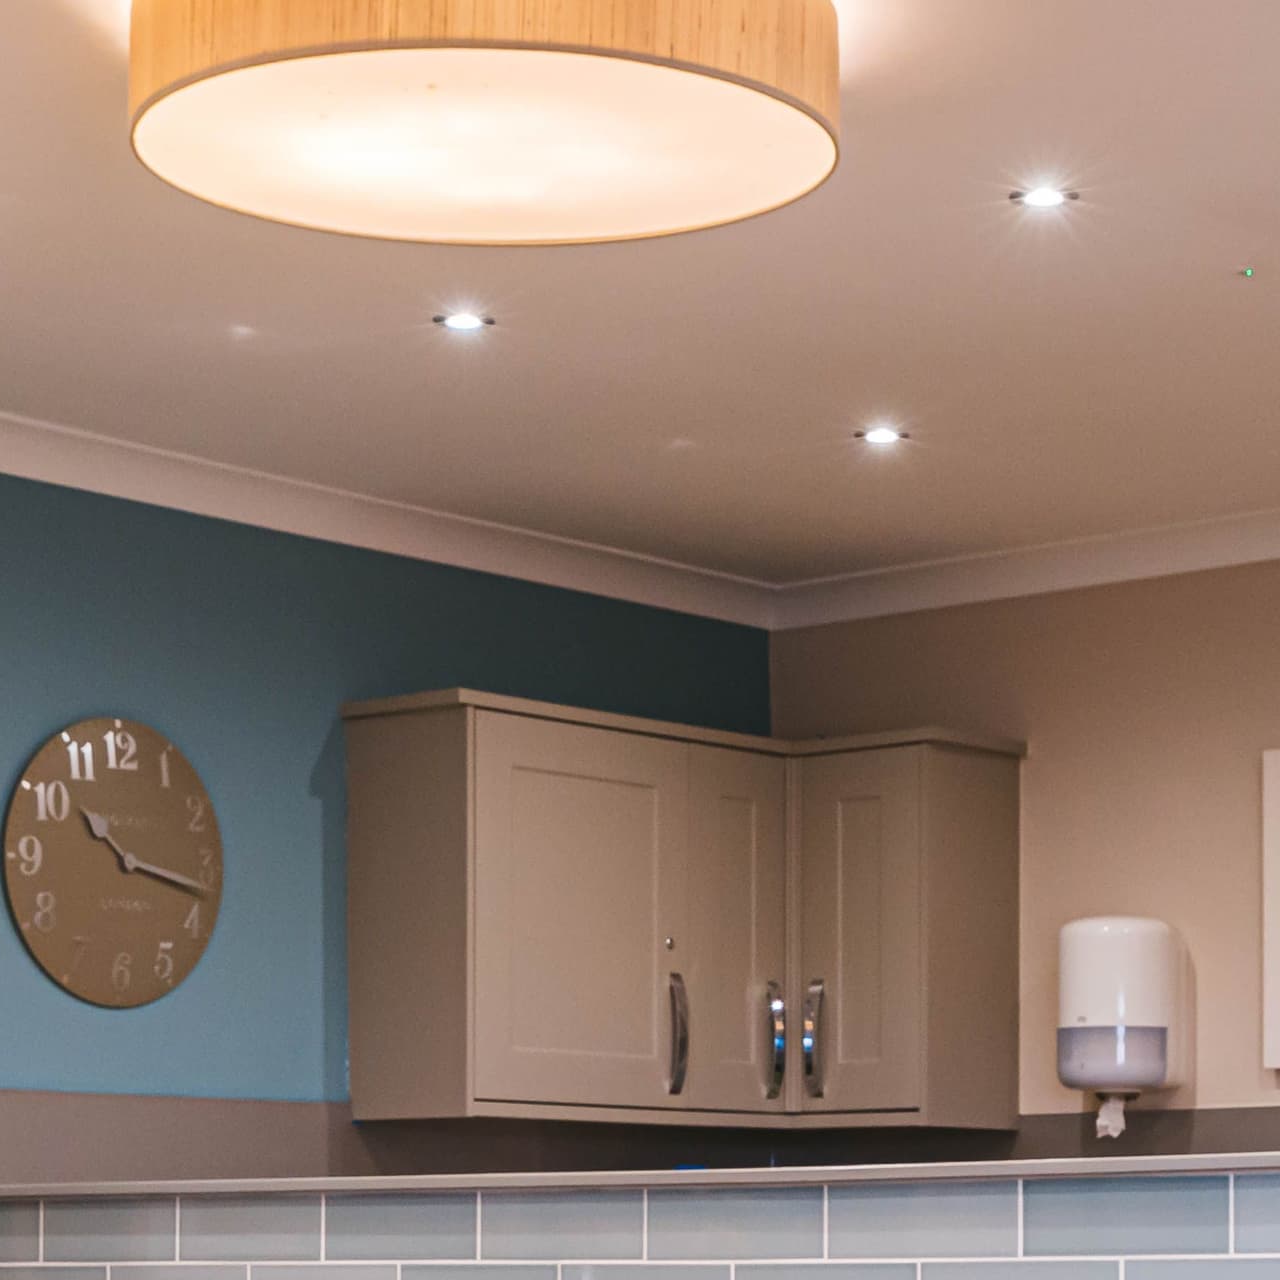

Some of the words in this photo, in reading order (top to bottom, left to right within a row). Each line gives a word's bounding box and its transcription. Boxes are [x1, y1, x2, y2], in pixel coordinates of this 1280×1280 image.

[67, 741, 96, 782] 11
[104, 731, 138, 770] 12
[160, 750, 170, 788] 1
[34, 780, 70, 821] 10
[186, 797, 204, 831] 2
[18, 836, 42, 875] 9
[200, 850, 217, 888] 3
[34, 892, 56, 931] 8
[184, 902, 202, 939] 4
[72, 935, 93, 970] 7
[112, 952, 131, 991] 6
[154, 942, 174, 983] 5
